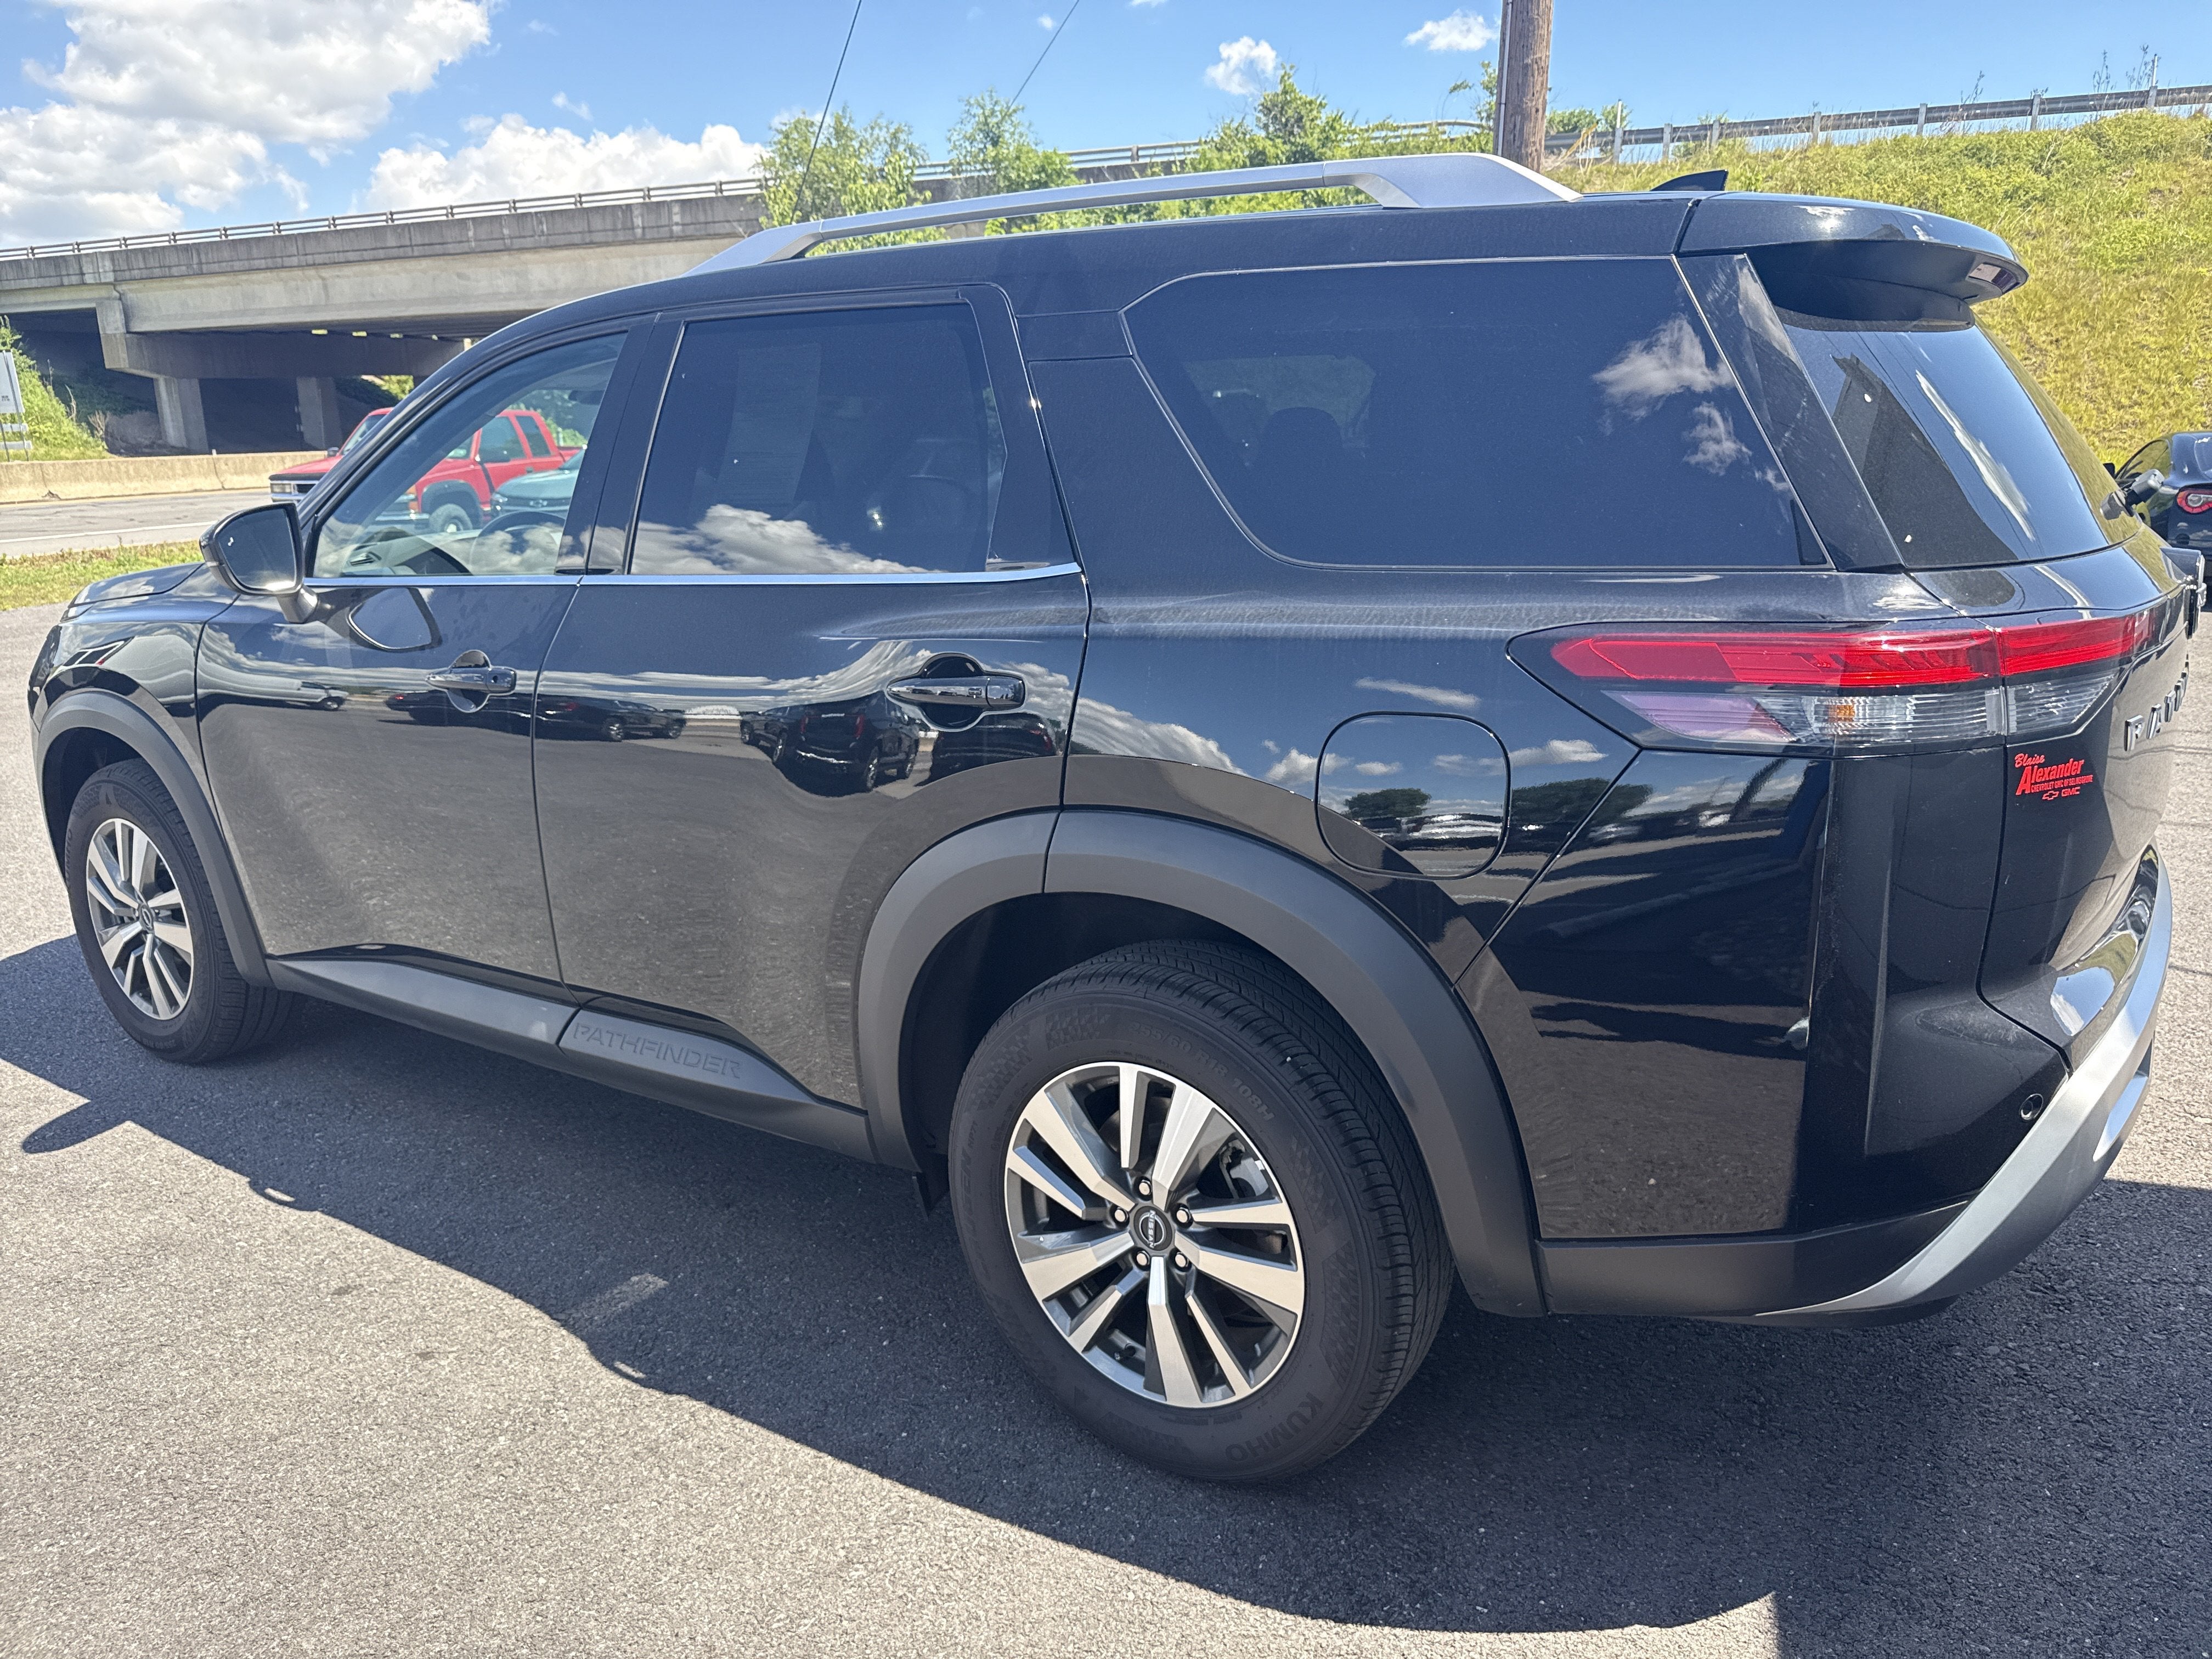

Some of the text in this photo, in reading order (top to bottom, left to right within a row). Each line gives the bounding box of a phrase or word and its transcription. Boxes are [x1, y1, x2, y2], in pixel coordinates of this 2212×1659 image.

[2015, 753, 2045, 768] Blaise
[2016, 758, 2084, 795] Alexander
[2061, 786, 2081, 797] GMC
[573, 1022, 741, 1079] PATHFINDER
[1129, 1020, 1275, 1121] 255/60 R18 108H
[1148, 1209, 1156, 1249] NISSAN
[1224, 1392, 1324, 1462] KUMHO
